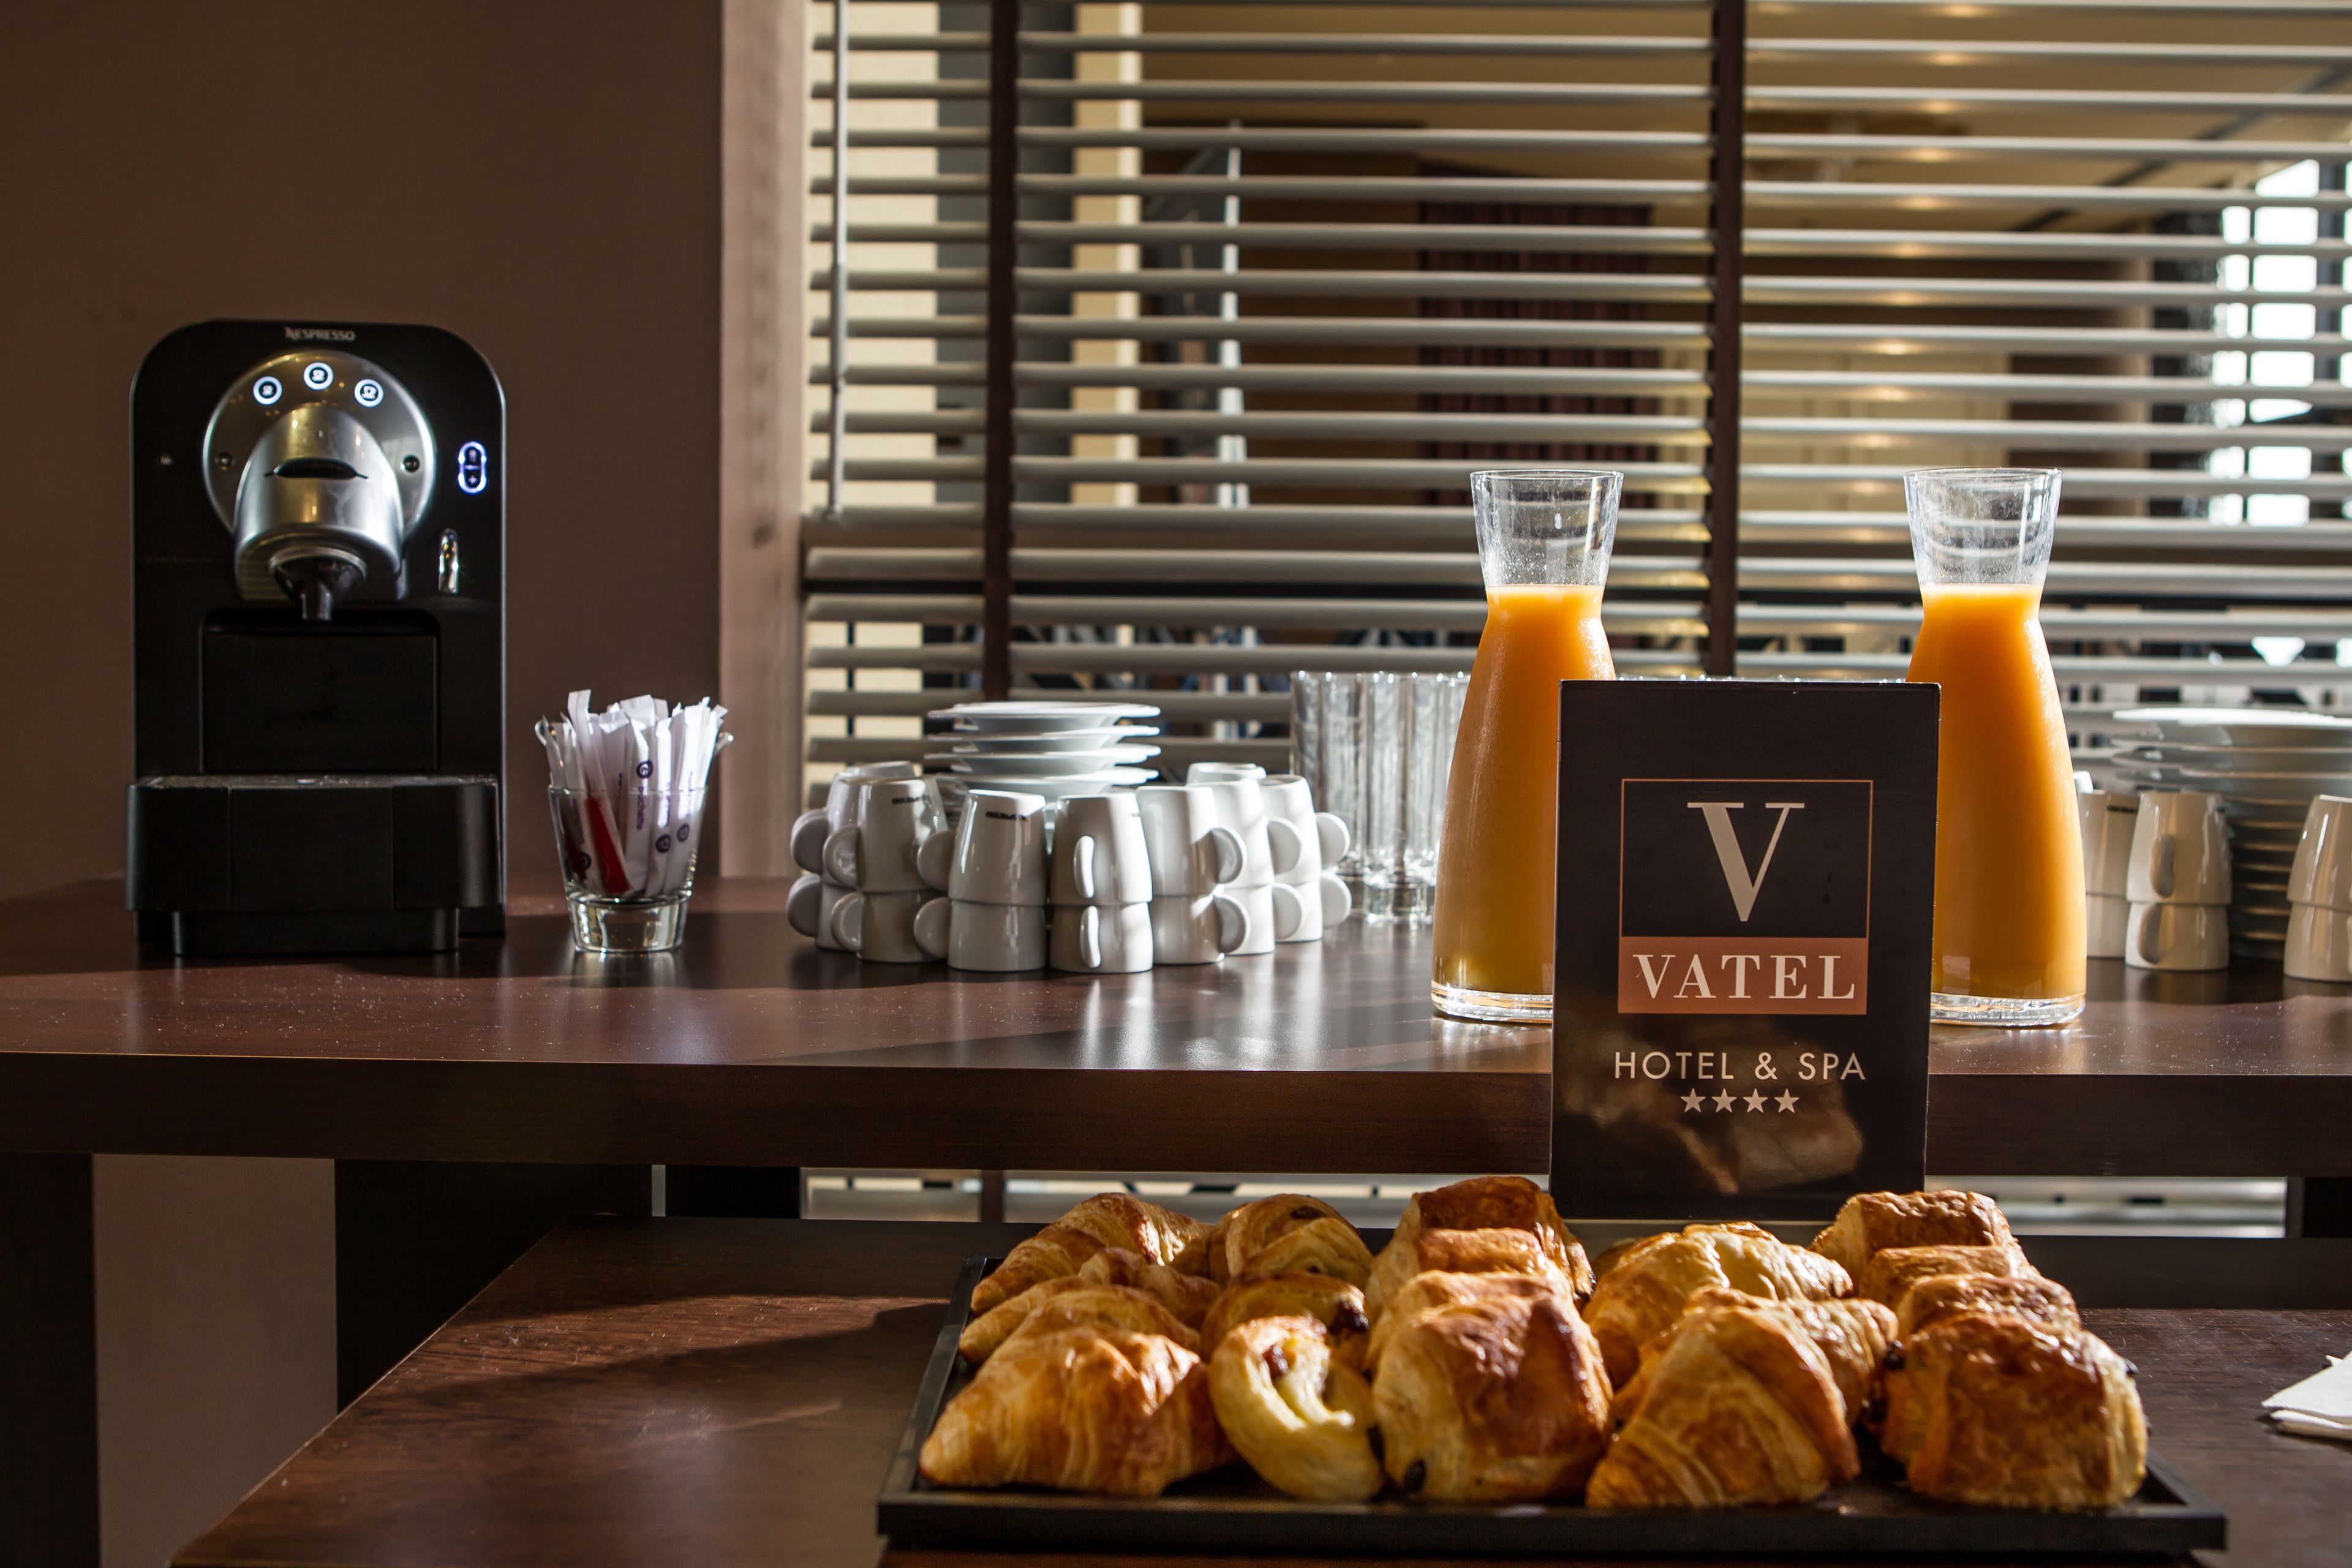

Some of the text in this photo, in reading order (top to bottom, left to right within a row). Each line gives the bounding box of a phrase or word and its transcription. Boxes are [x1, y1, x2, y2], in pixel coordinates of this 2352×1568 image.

[1687, 802, 1805, 922] V
[1632, 954, 1855, 999] VATEL
[1615, 1052, 1866, 1080] HOTEL & SPA
